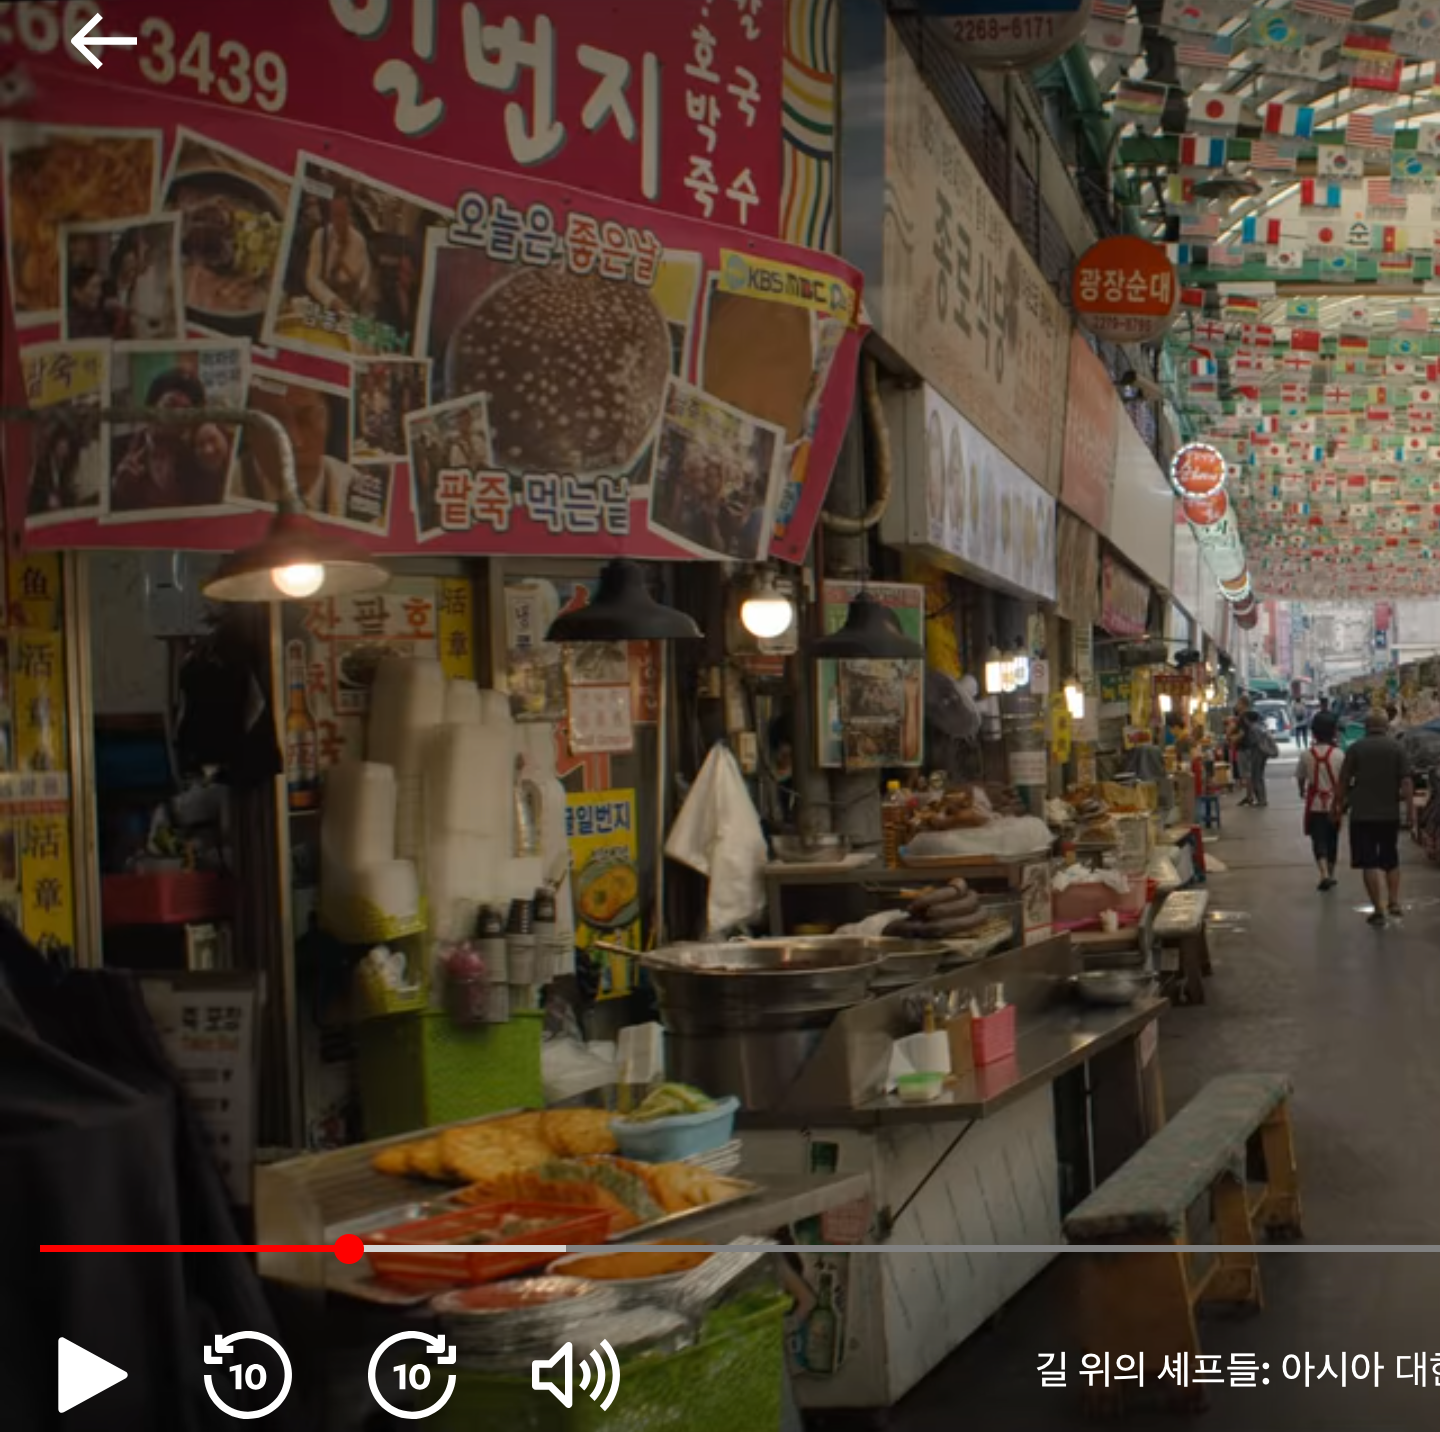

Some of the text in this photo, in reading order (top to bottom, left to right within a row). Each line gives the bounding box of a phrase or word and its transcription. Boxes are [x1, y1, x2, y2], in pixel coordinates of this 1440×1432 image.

[328, 0, 662, 203] 일번지
[683, 23, 721, 219] 호박죽
[450, 191, 557, 266] 오늘은
[748, 266, 784, 294] KBS
[1079, 267, 1172, 305] 광장순대
[435, 468, 513, 531] 팥죽
